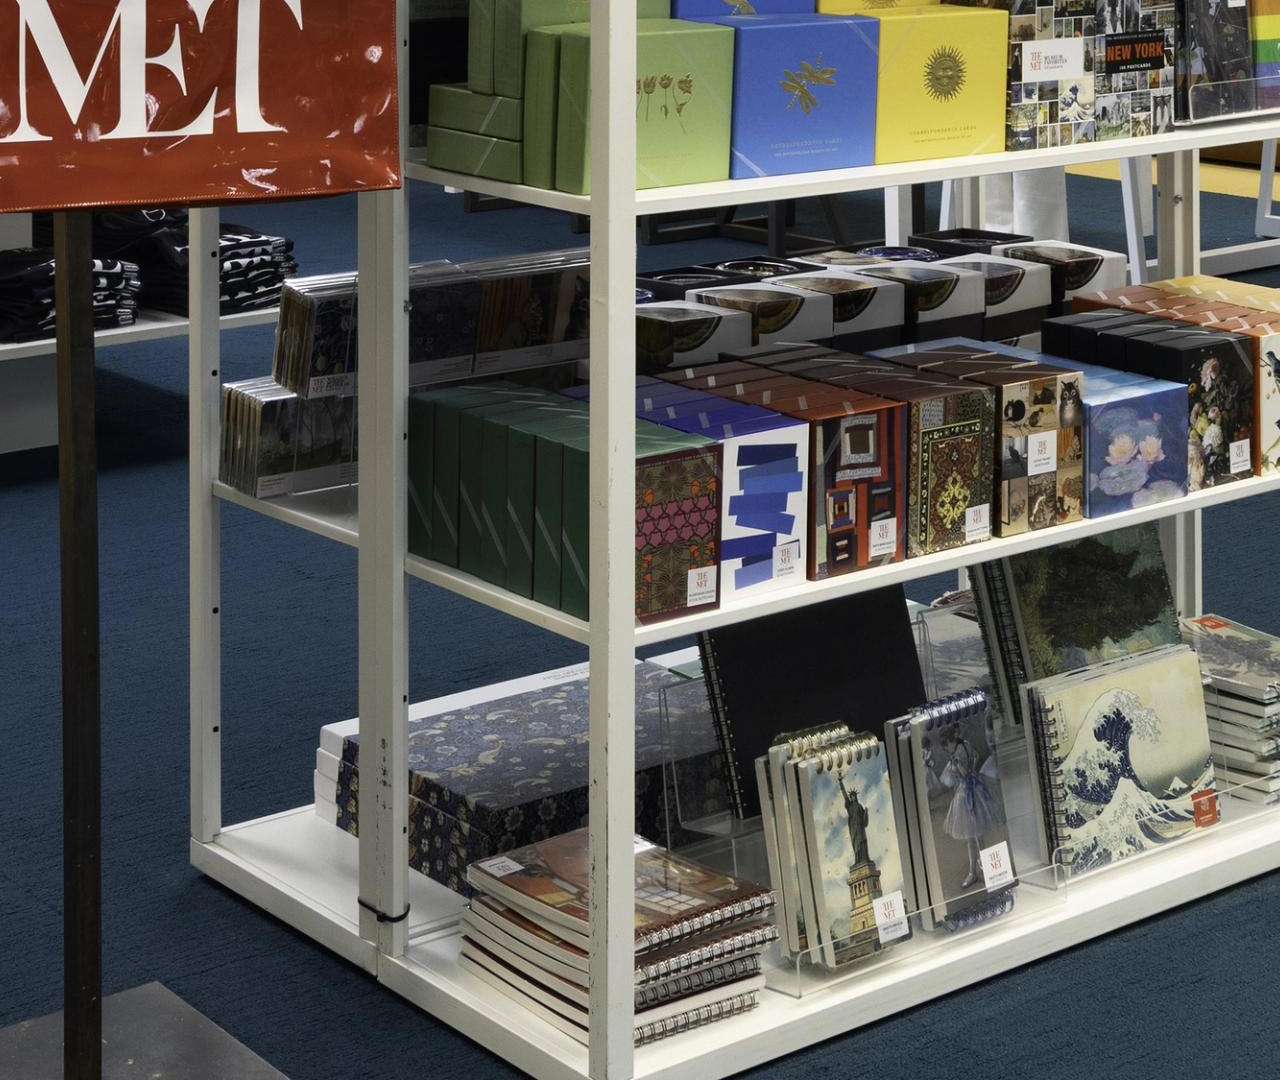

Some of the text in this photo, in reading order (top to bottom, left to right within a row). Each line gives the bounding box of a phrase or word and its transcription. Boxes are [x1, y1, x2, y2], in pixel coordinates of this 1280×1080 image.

[1031, 51, 1042, 61] THE
[1107, 41, 1165, 61] NEW YORK
